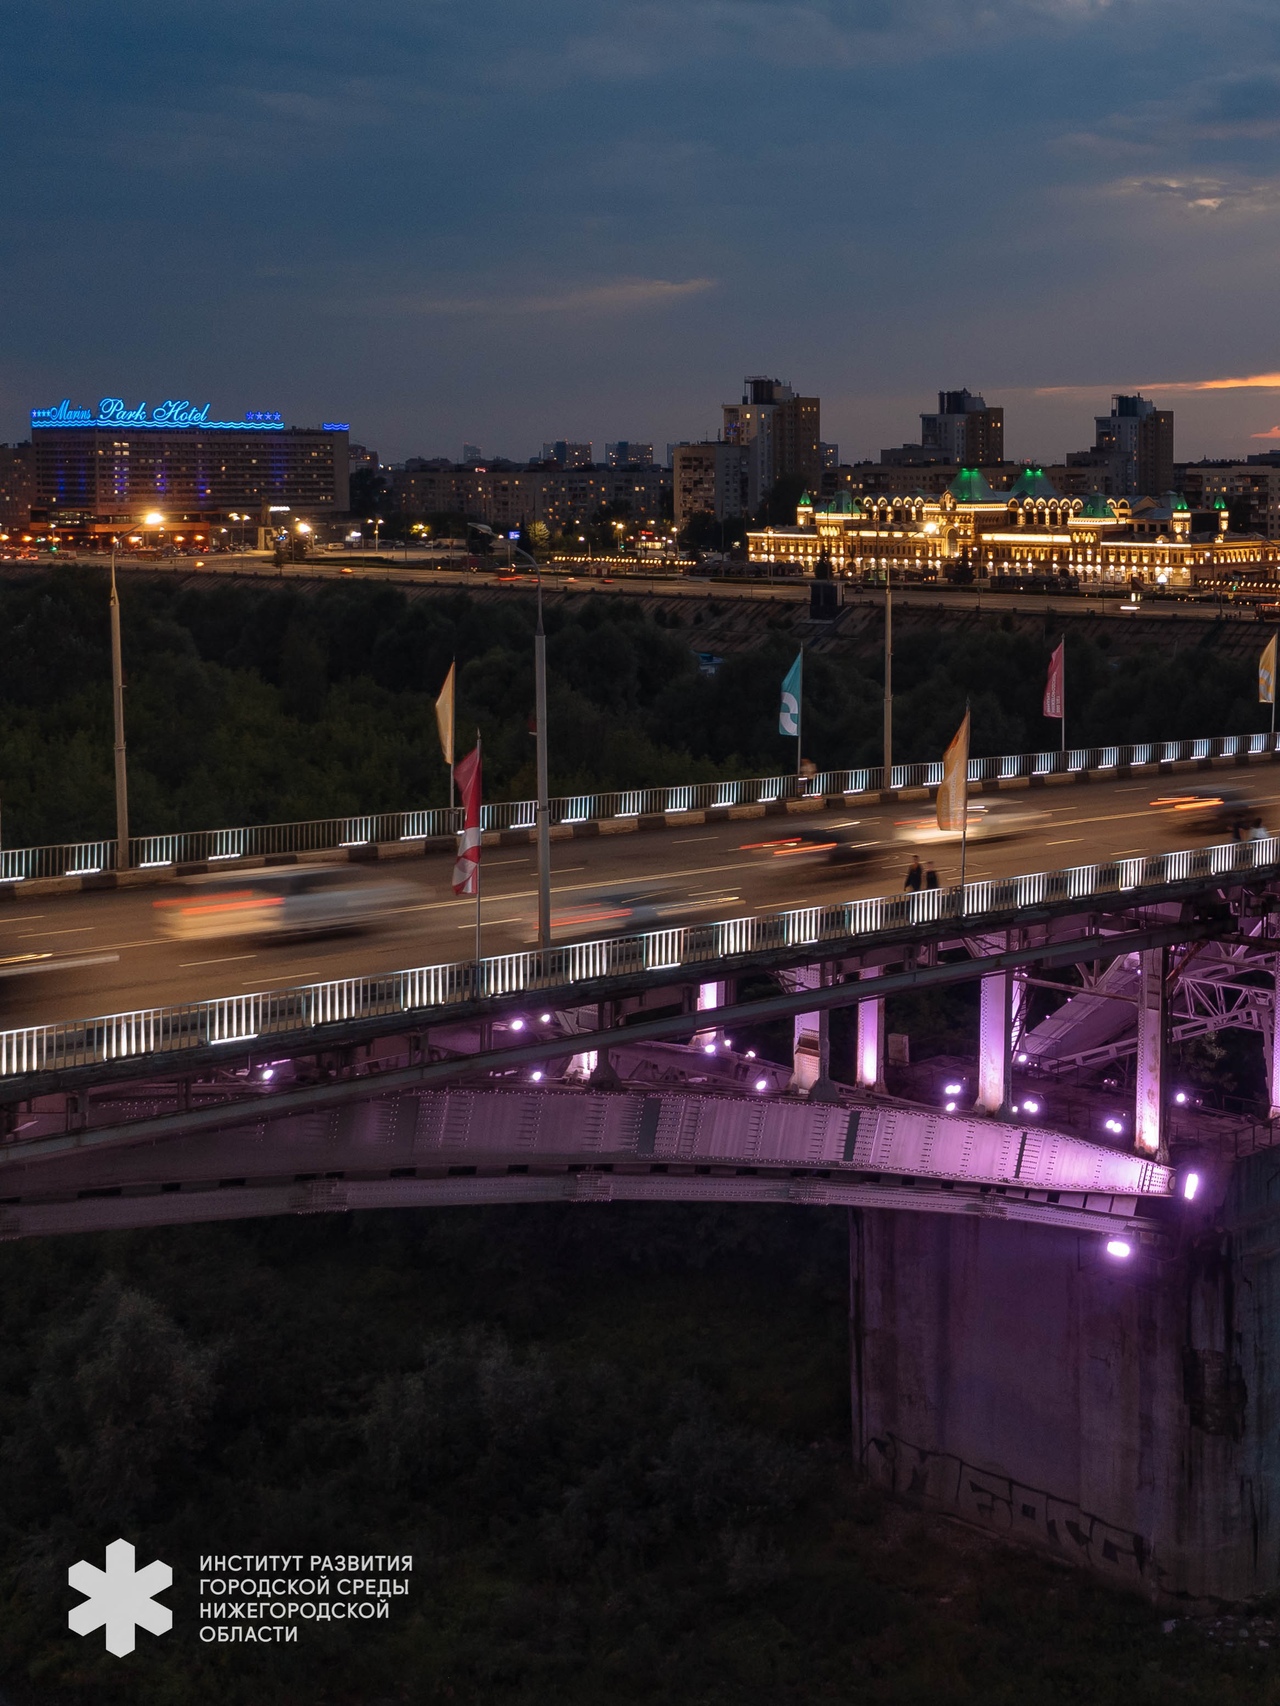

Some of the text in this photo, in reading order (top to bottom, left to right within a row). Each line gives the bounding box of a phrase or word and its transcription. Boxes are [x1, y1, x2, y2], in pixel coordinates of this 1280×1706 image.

[50, 398, 211, 422] Marins Park Hotel
